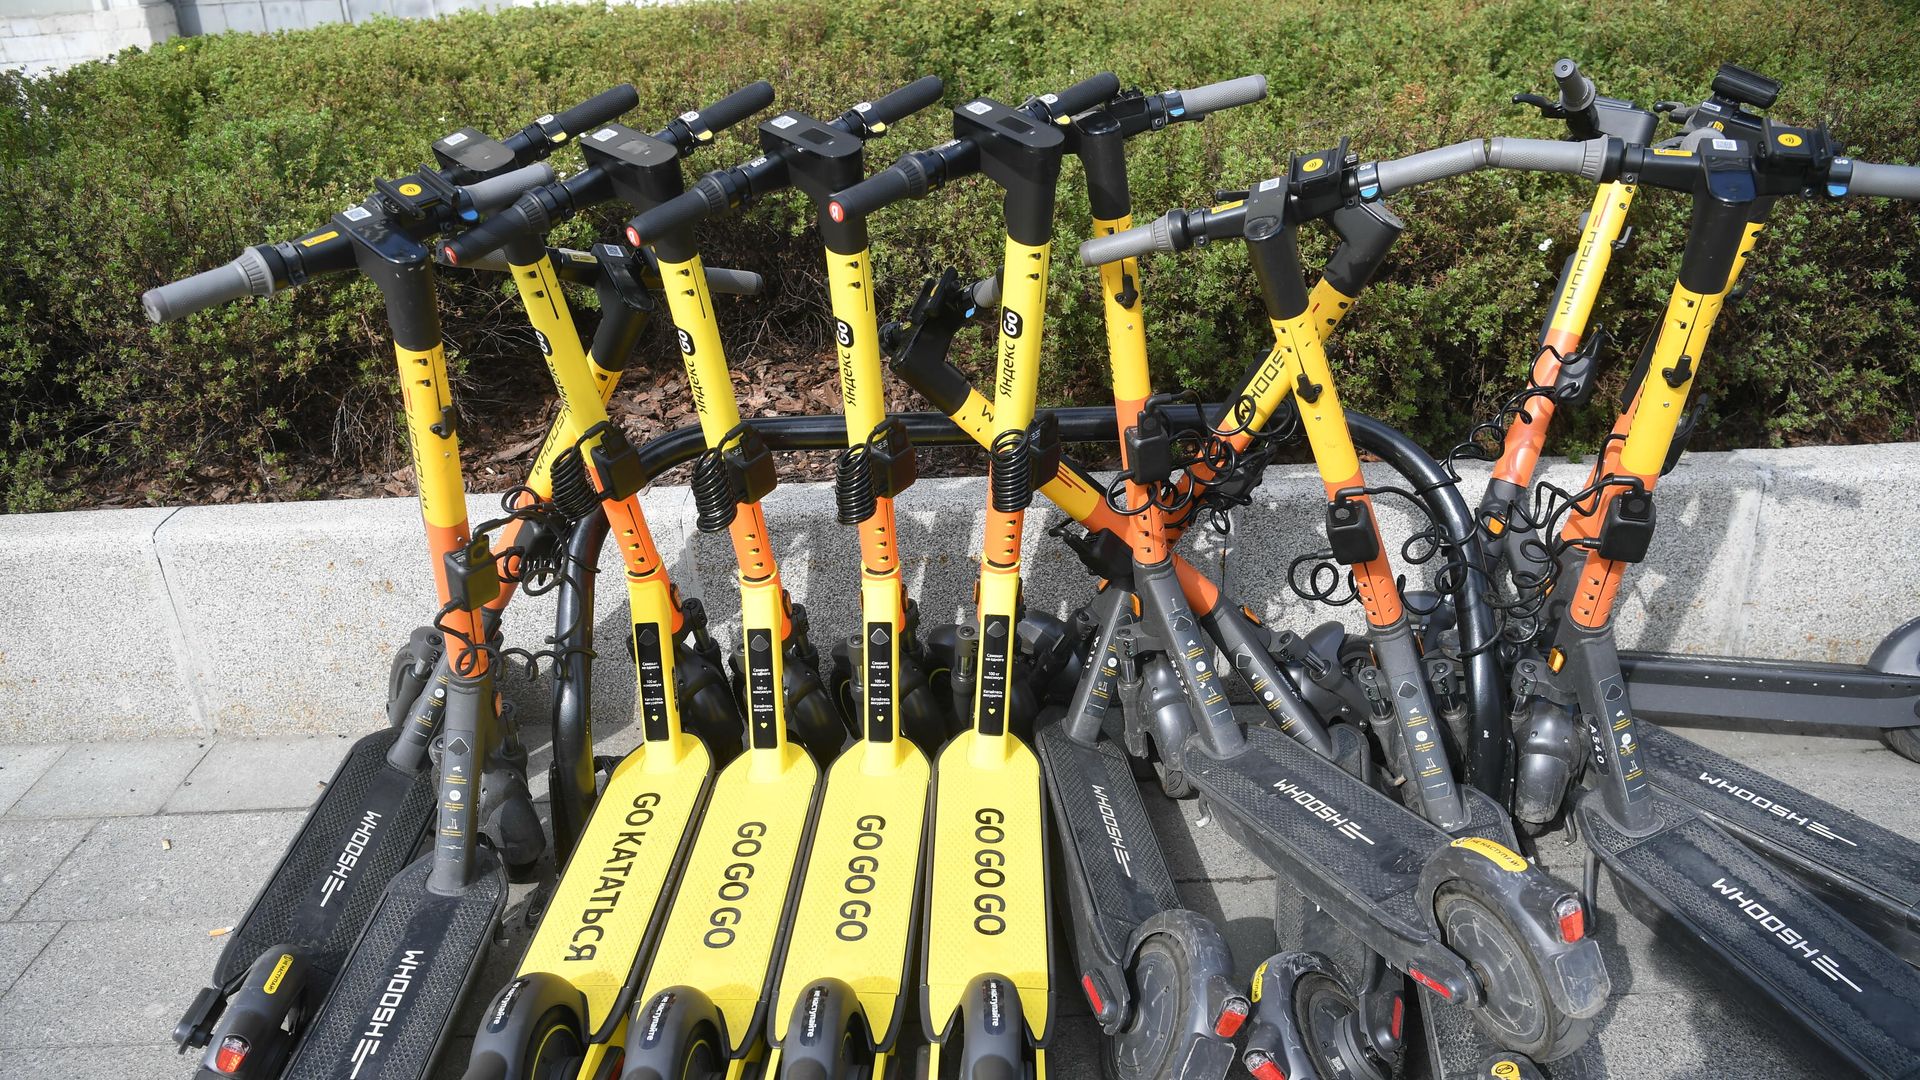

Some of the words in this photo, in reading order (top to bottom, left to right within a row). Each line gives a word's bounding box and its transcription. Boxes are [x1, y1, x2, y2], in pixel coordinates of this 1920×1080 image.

[678, 329, 692, 353] Go
[836, 321, 850, 345] Go
[1003, 311, 1018, 336] Go
[686, 359, 708, 414] Яндекс
[841, 350, 857, 407] Яндекс
[1000, 340, 1016, 398] Яндекс
[1589, 724, 1605, 764] A540
[625, 792, 661, 826] GO
[1092, 784, 1126, 849] WHOOSH
[1272, 778, 1349, 827] WHOOSH
[1699, 771, 1809, 827] WHOOSH
[333, 811, 382, 878] WHOOSH
[732, 822, 767, 857] GO
[854, 815, 886, 850] GO
[975, 808, 1005, 843] GO
[719, 863, 755, 900] GO
[845, 856, 879, 893] GO
[974, 850, 1006, 887] GO
[564, 832, 646, 962] КАТАТЬСЯ
[974, 894, 1006, 935] GO
[1711, 877, 1820, 958] WHOOSH
[704, 908, 742, 949] GO
[836, 901, 871, 942] GO
[365, 950, 424, 1037] WHOOSH
